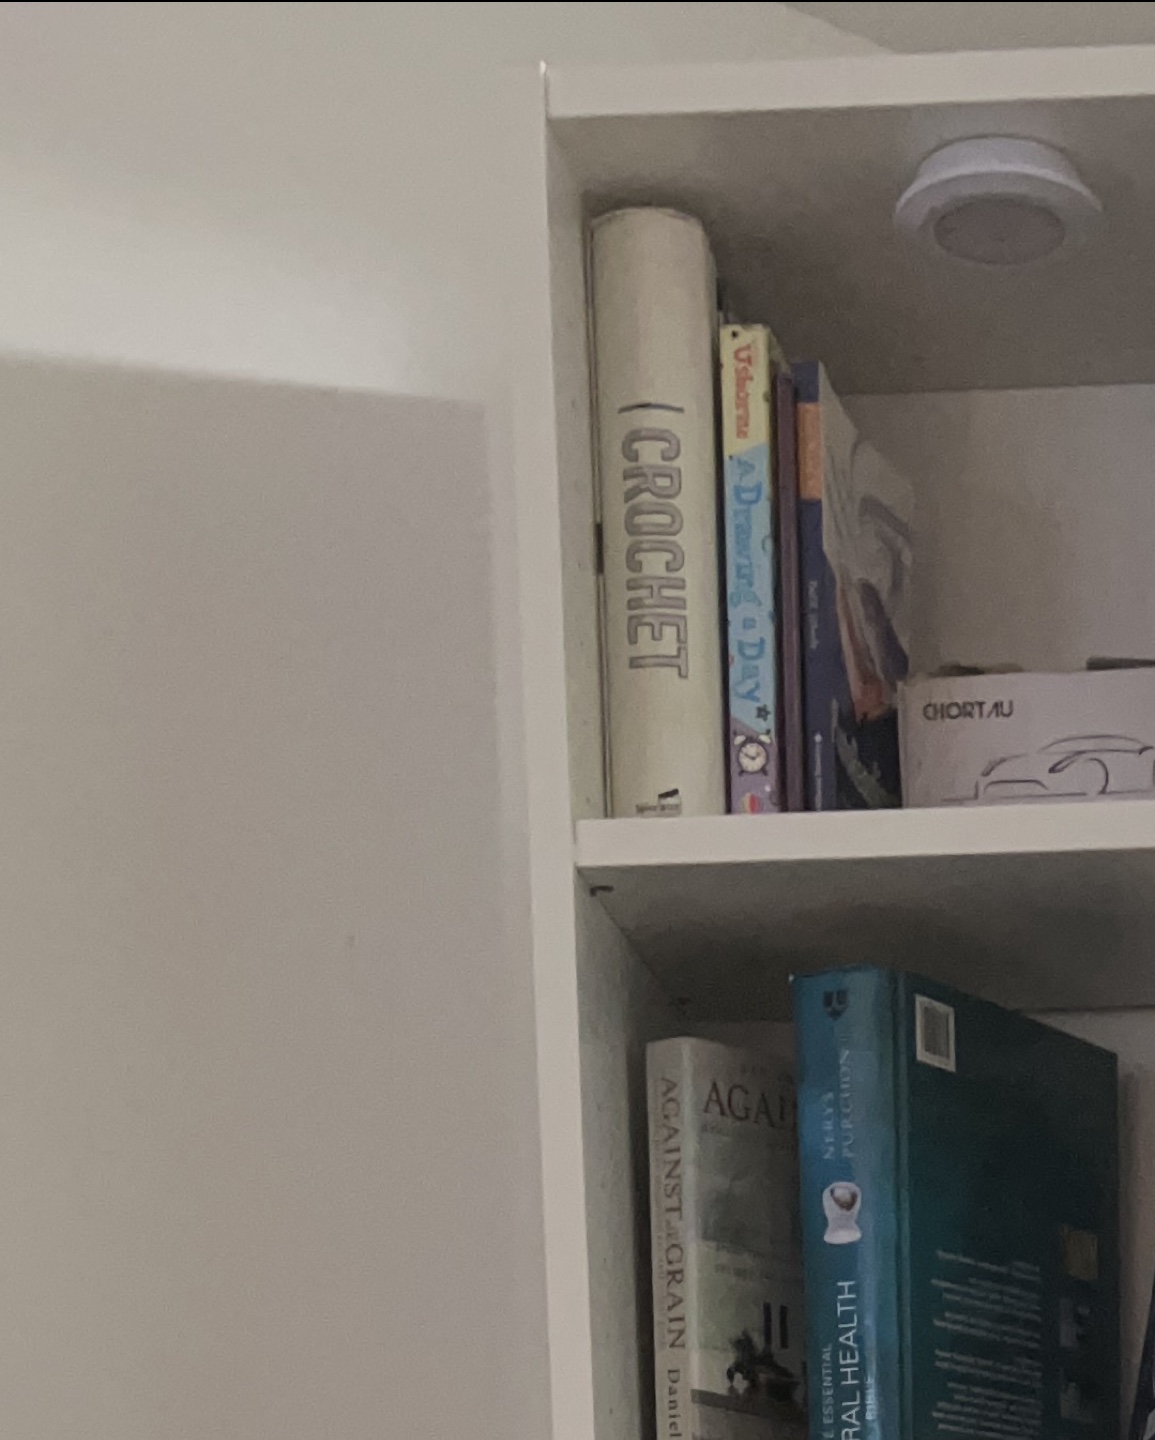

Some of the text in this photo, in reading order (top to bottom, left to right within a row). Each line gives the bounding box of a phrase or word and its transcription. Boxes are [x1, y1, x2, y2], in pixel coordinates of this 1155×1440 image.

[733, 343, 755, 440] Usborne
[736, 457, 757, 483] A
[621, 427, 690, 680] CROCHET
[729, 481, 764, 608] Drawing
[732, 636, 767, 704] Day
[922, 699, 1014, 721] CHORTAU
[660, 1076, 684, 1221] AGAINST
[702, 1080, 799, 1132] AGAI
[664, 1242, 687, 1351] GRAIN
[836, 1280, 860, 1385] HEALTH
[821, 1342, 835, 1424] ESSENTIAL
